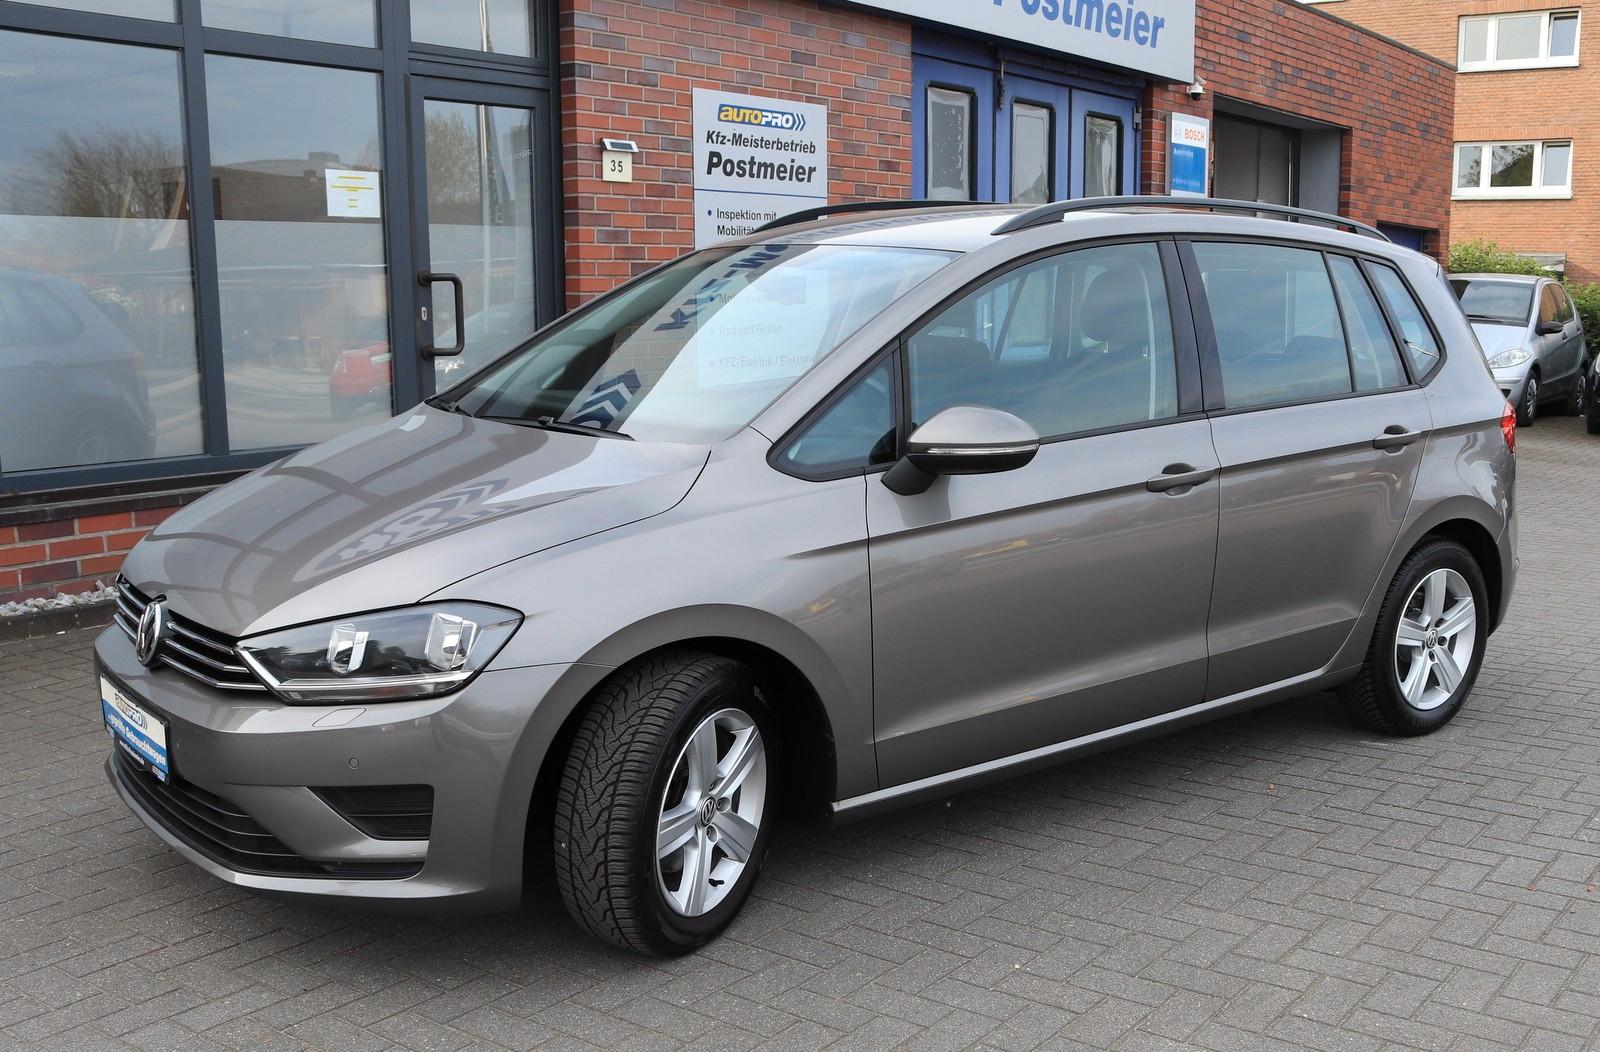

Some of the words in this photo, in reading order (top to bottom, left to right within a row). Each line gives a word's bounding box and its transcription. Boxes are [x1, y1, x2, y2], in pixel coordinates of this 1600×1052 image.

[993, 0, 1165, 48] stmeier
[706, 130, 816, 154] Kfz-Meisterbetrieb
[1184, 128, 1205, 142] BOSCH
[610, 159, 624, 173] 35
[706, 151, 817, 183] Postmeier
[716, 207, 762, 221] Inspektion
[763, 211, 777, 221] mit
